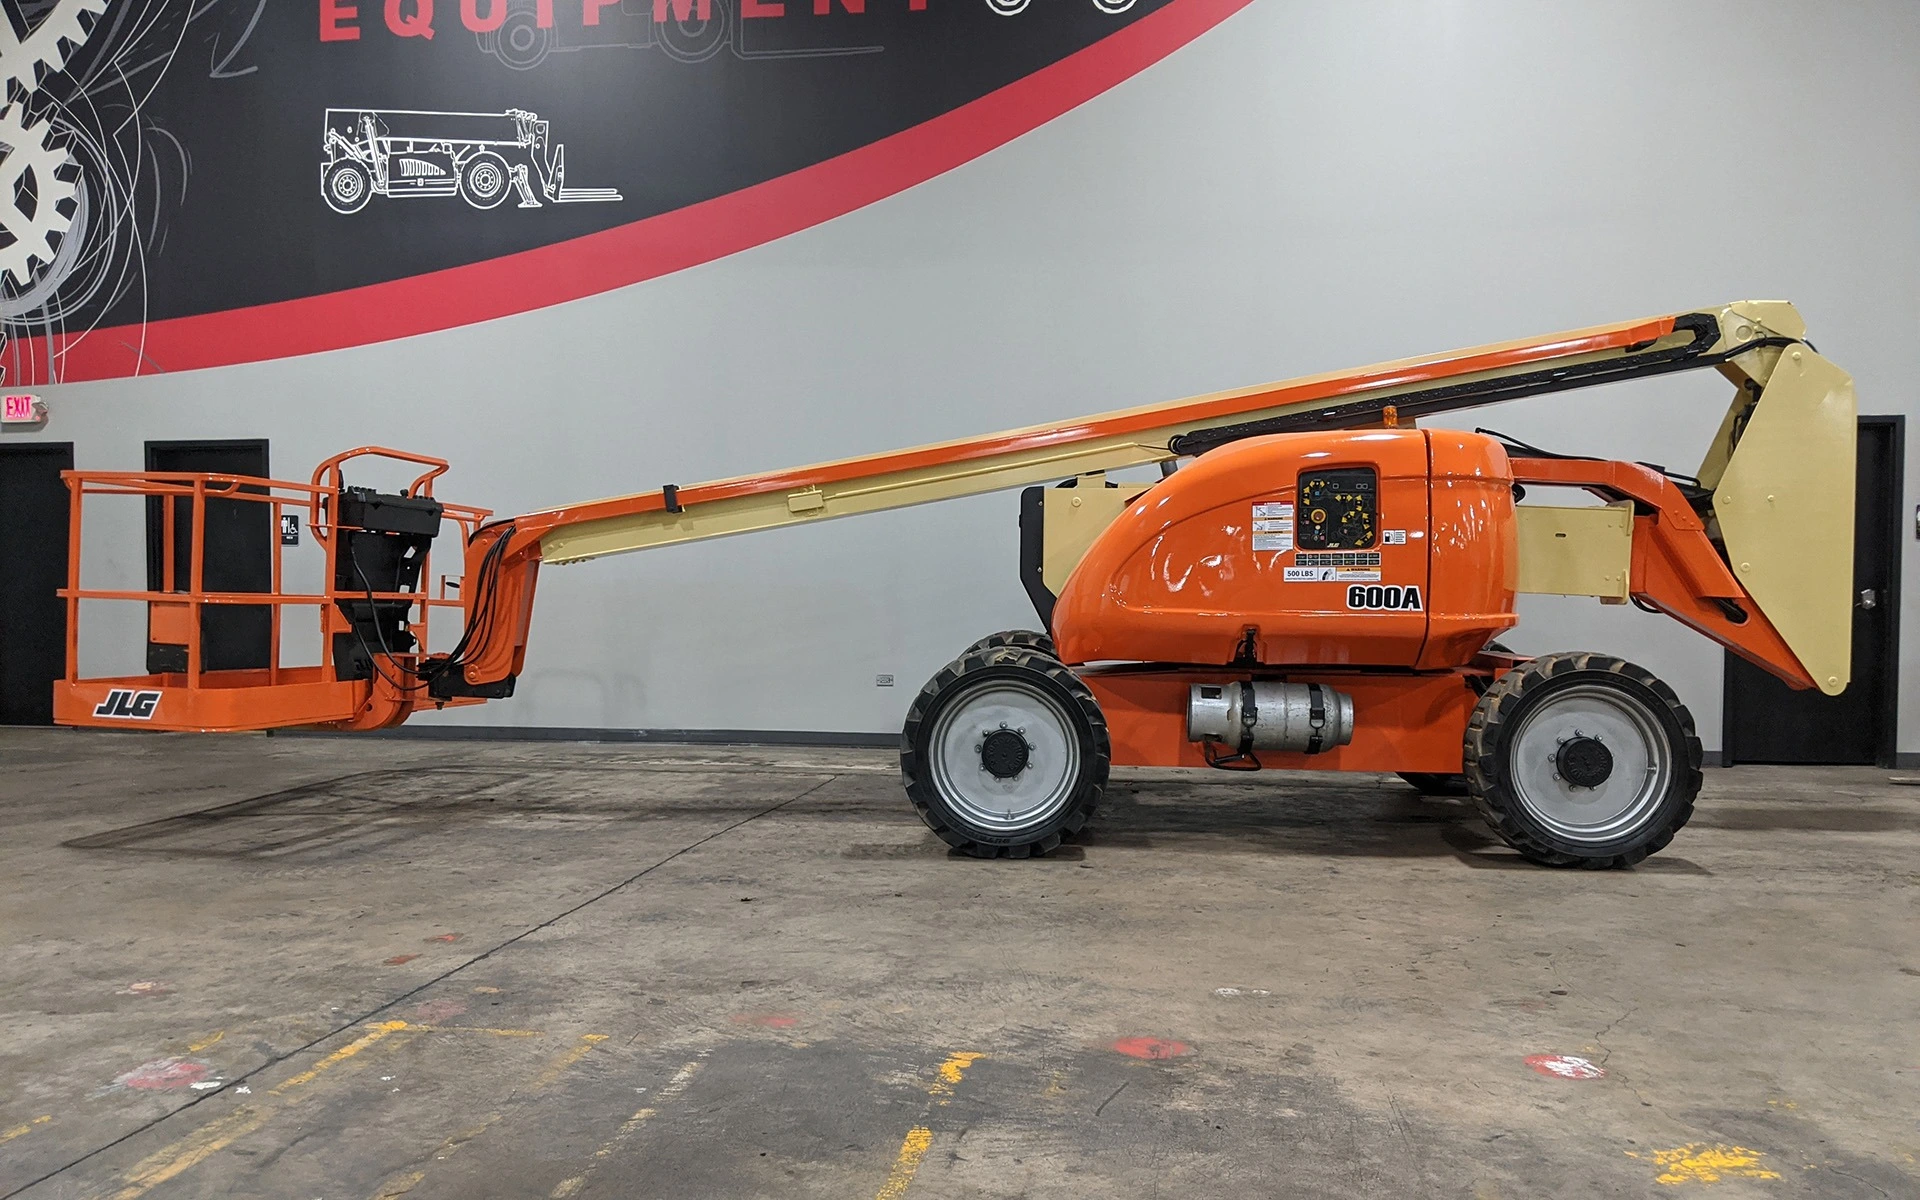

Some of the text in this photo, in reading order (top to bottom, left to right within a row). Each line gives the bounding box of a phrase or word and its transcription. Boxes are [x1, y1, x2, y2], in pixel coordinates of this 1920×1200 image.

[319, 0, 927, 42] EQUIP
[6, 396, 31, 418] EXIT
[1347, 585, 1422, 610] 600A
[93, 689, 163, 720] JLG
